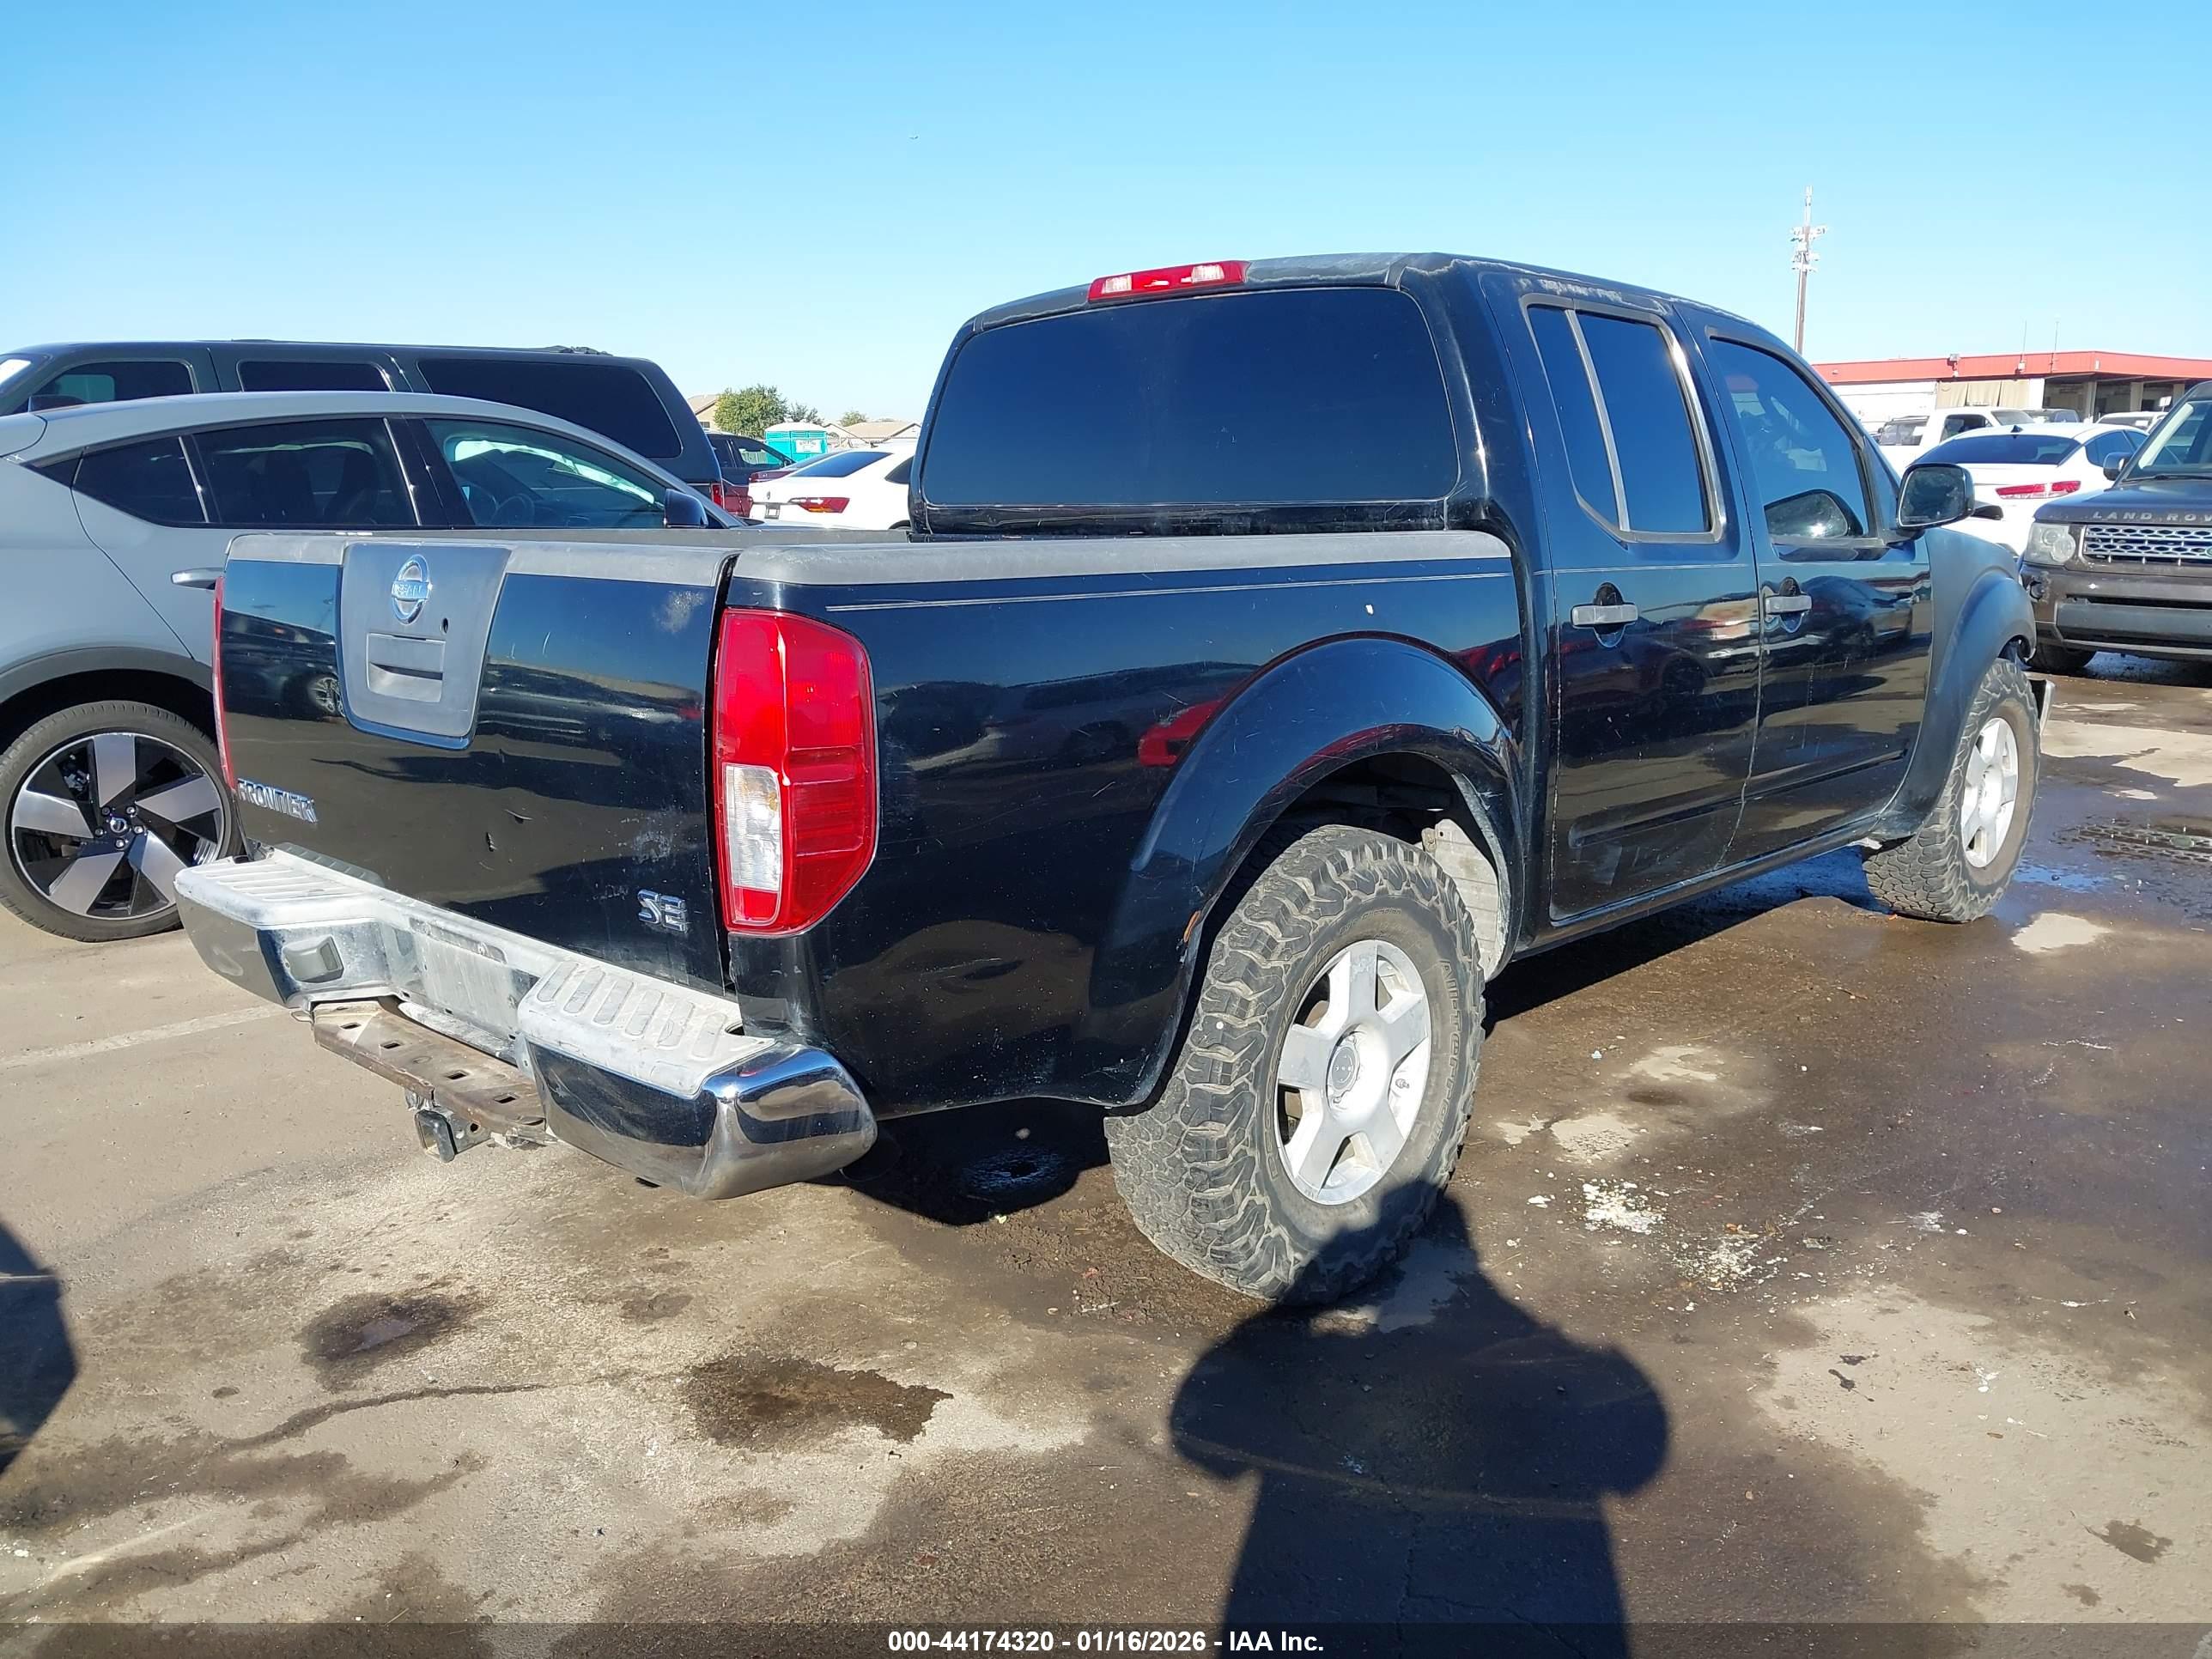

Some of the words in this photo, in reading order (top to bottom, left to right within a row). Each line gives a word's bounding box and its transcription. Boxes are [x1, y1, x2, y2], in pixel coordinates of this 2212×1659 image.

[2093, 511, 2153, 520] LAND
[238, 778, 317, 823] FRONTIER
[637, 889, 687, 933] SE
